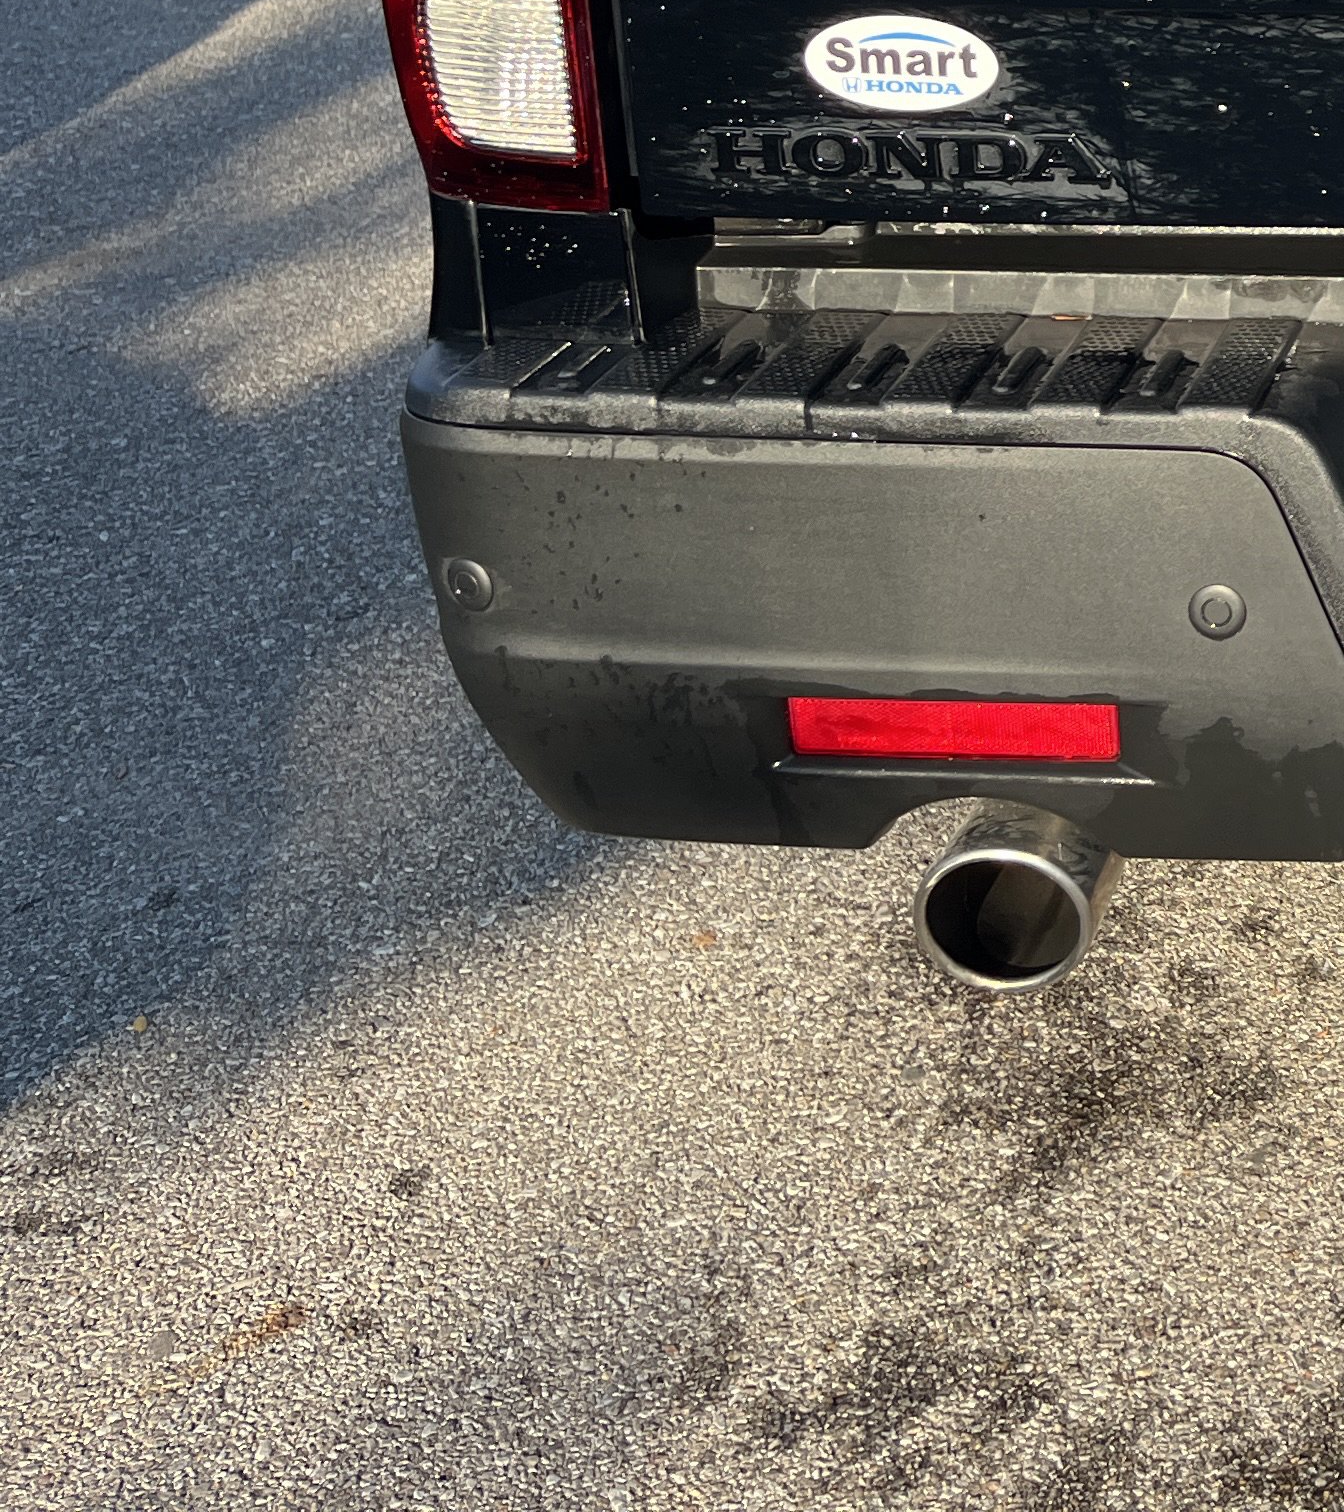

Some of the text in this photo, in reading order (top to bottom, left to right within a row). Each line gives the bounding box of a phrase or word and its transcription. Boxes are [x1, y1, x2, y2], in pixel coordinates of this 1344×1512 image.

[826, 36, 977, 79] Smart
[865, 79, 963, 96] HONDA
[706, 125, 1112, 188] HONDA
